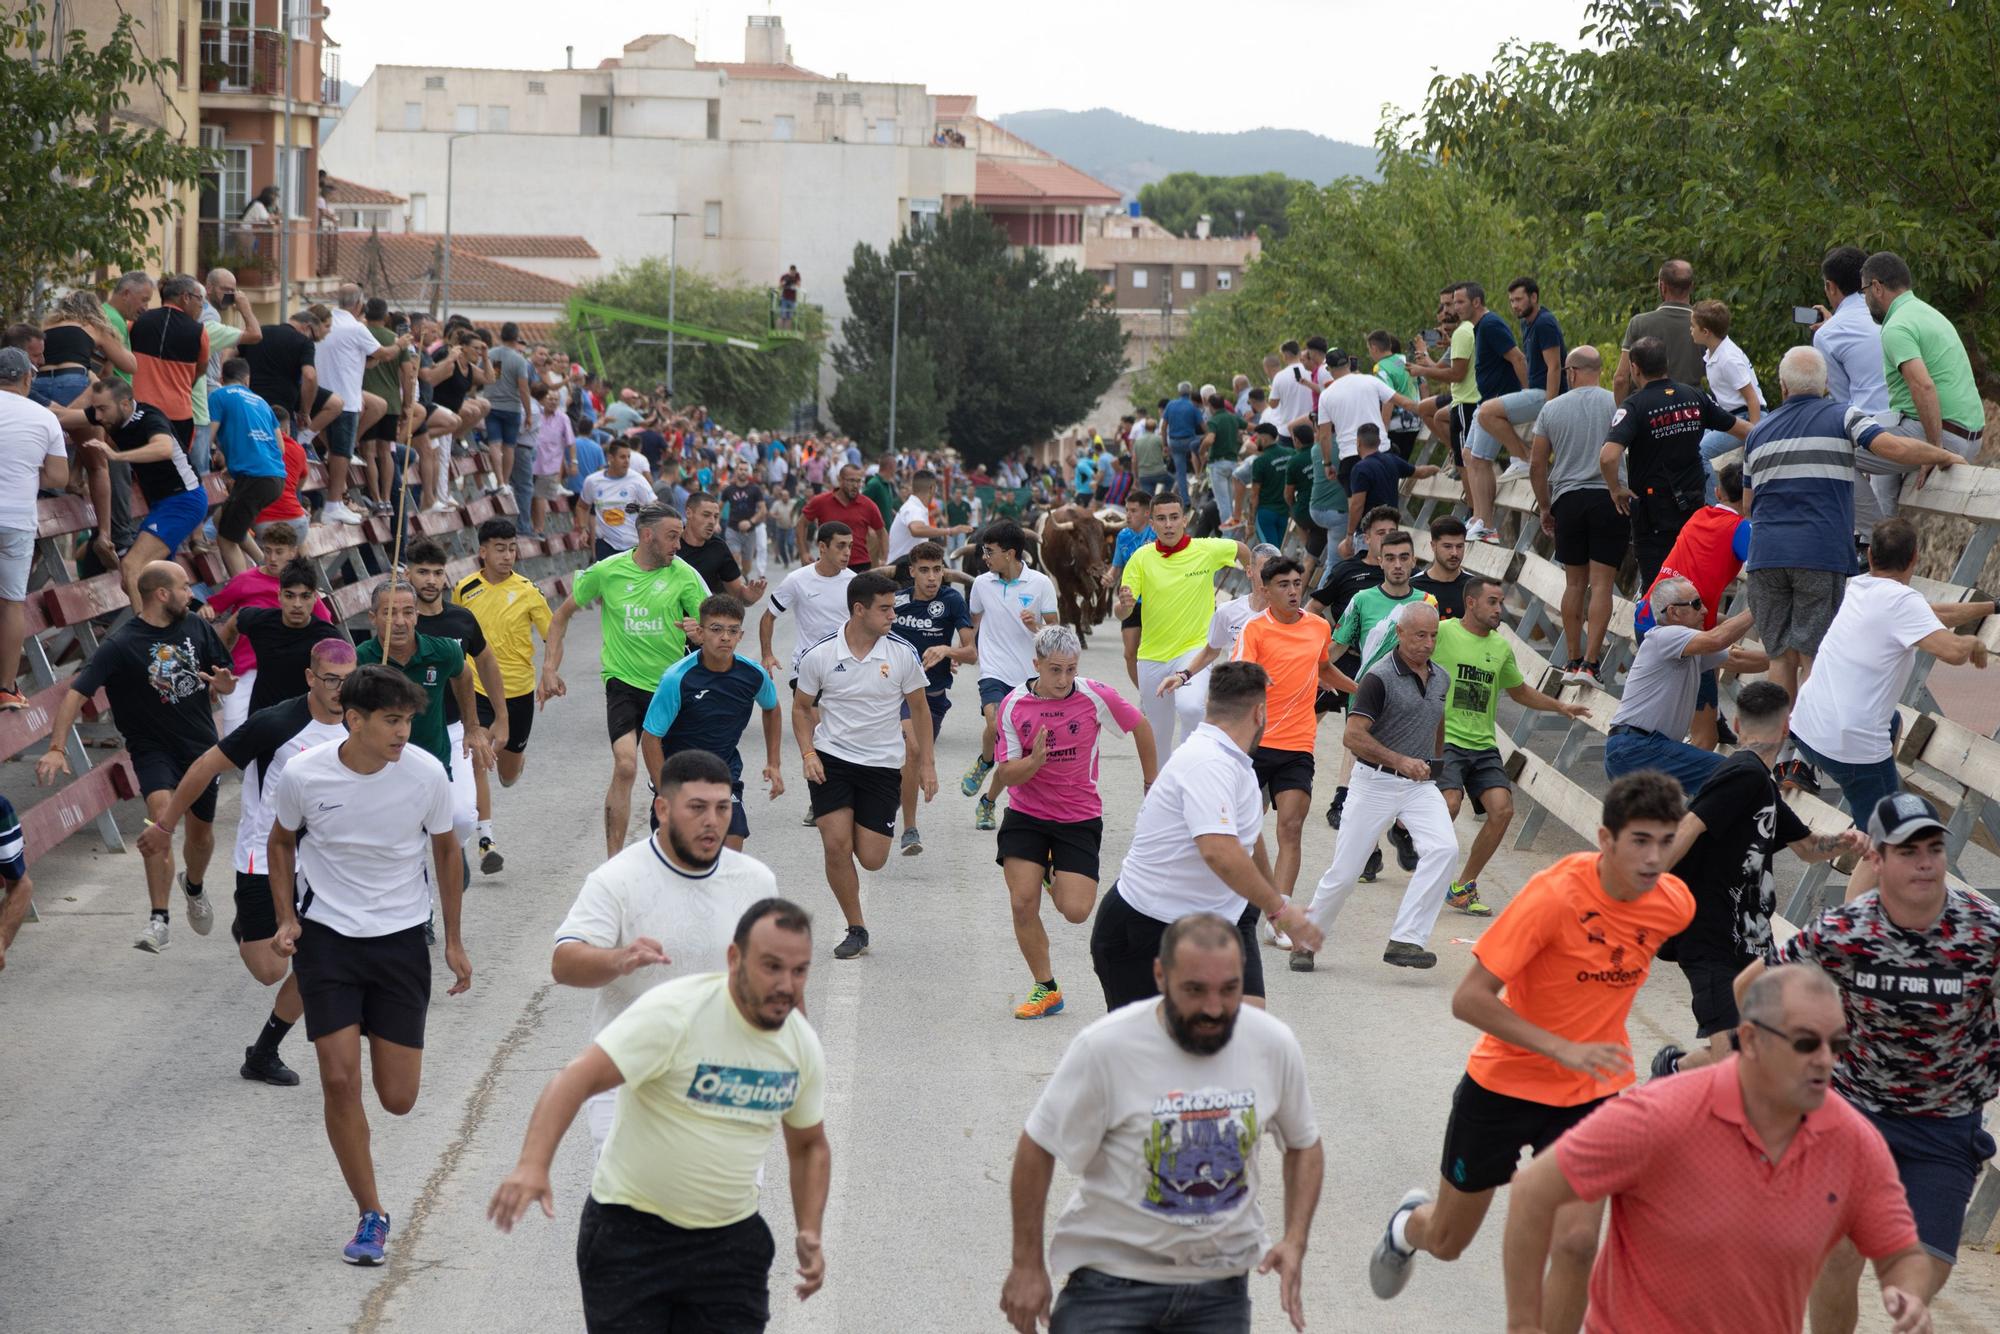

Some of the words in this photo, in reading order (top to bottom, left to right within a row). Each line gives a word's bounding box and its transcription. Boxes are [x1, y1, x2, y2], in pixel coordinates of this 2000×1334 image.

[624, 616, 664, 631] Resti
[1881, 974, 1896, 991] IT
[1899, 976, 1929, 994] FOR
[1933, 977, 1962, 995] YOU
